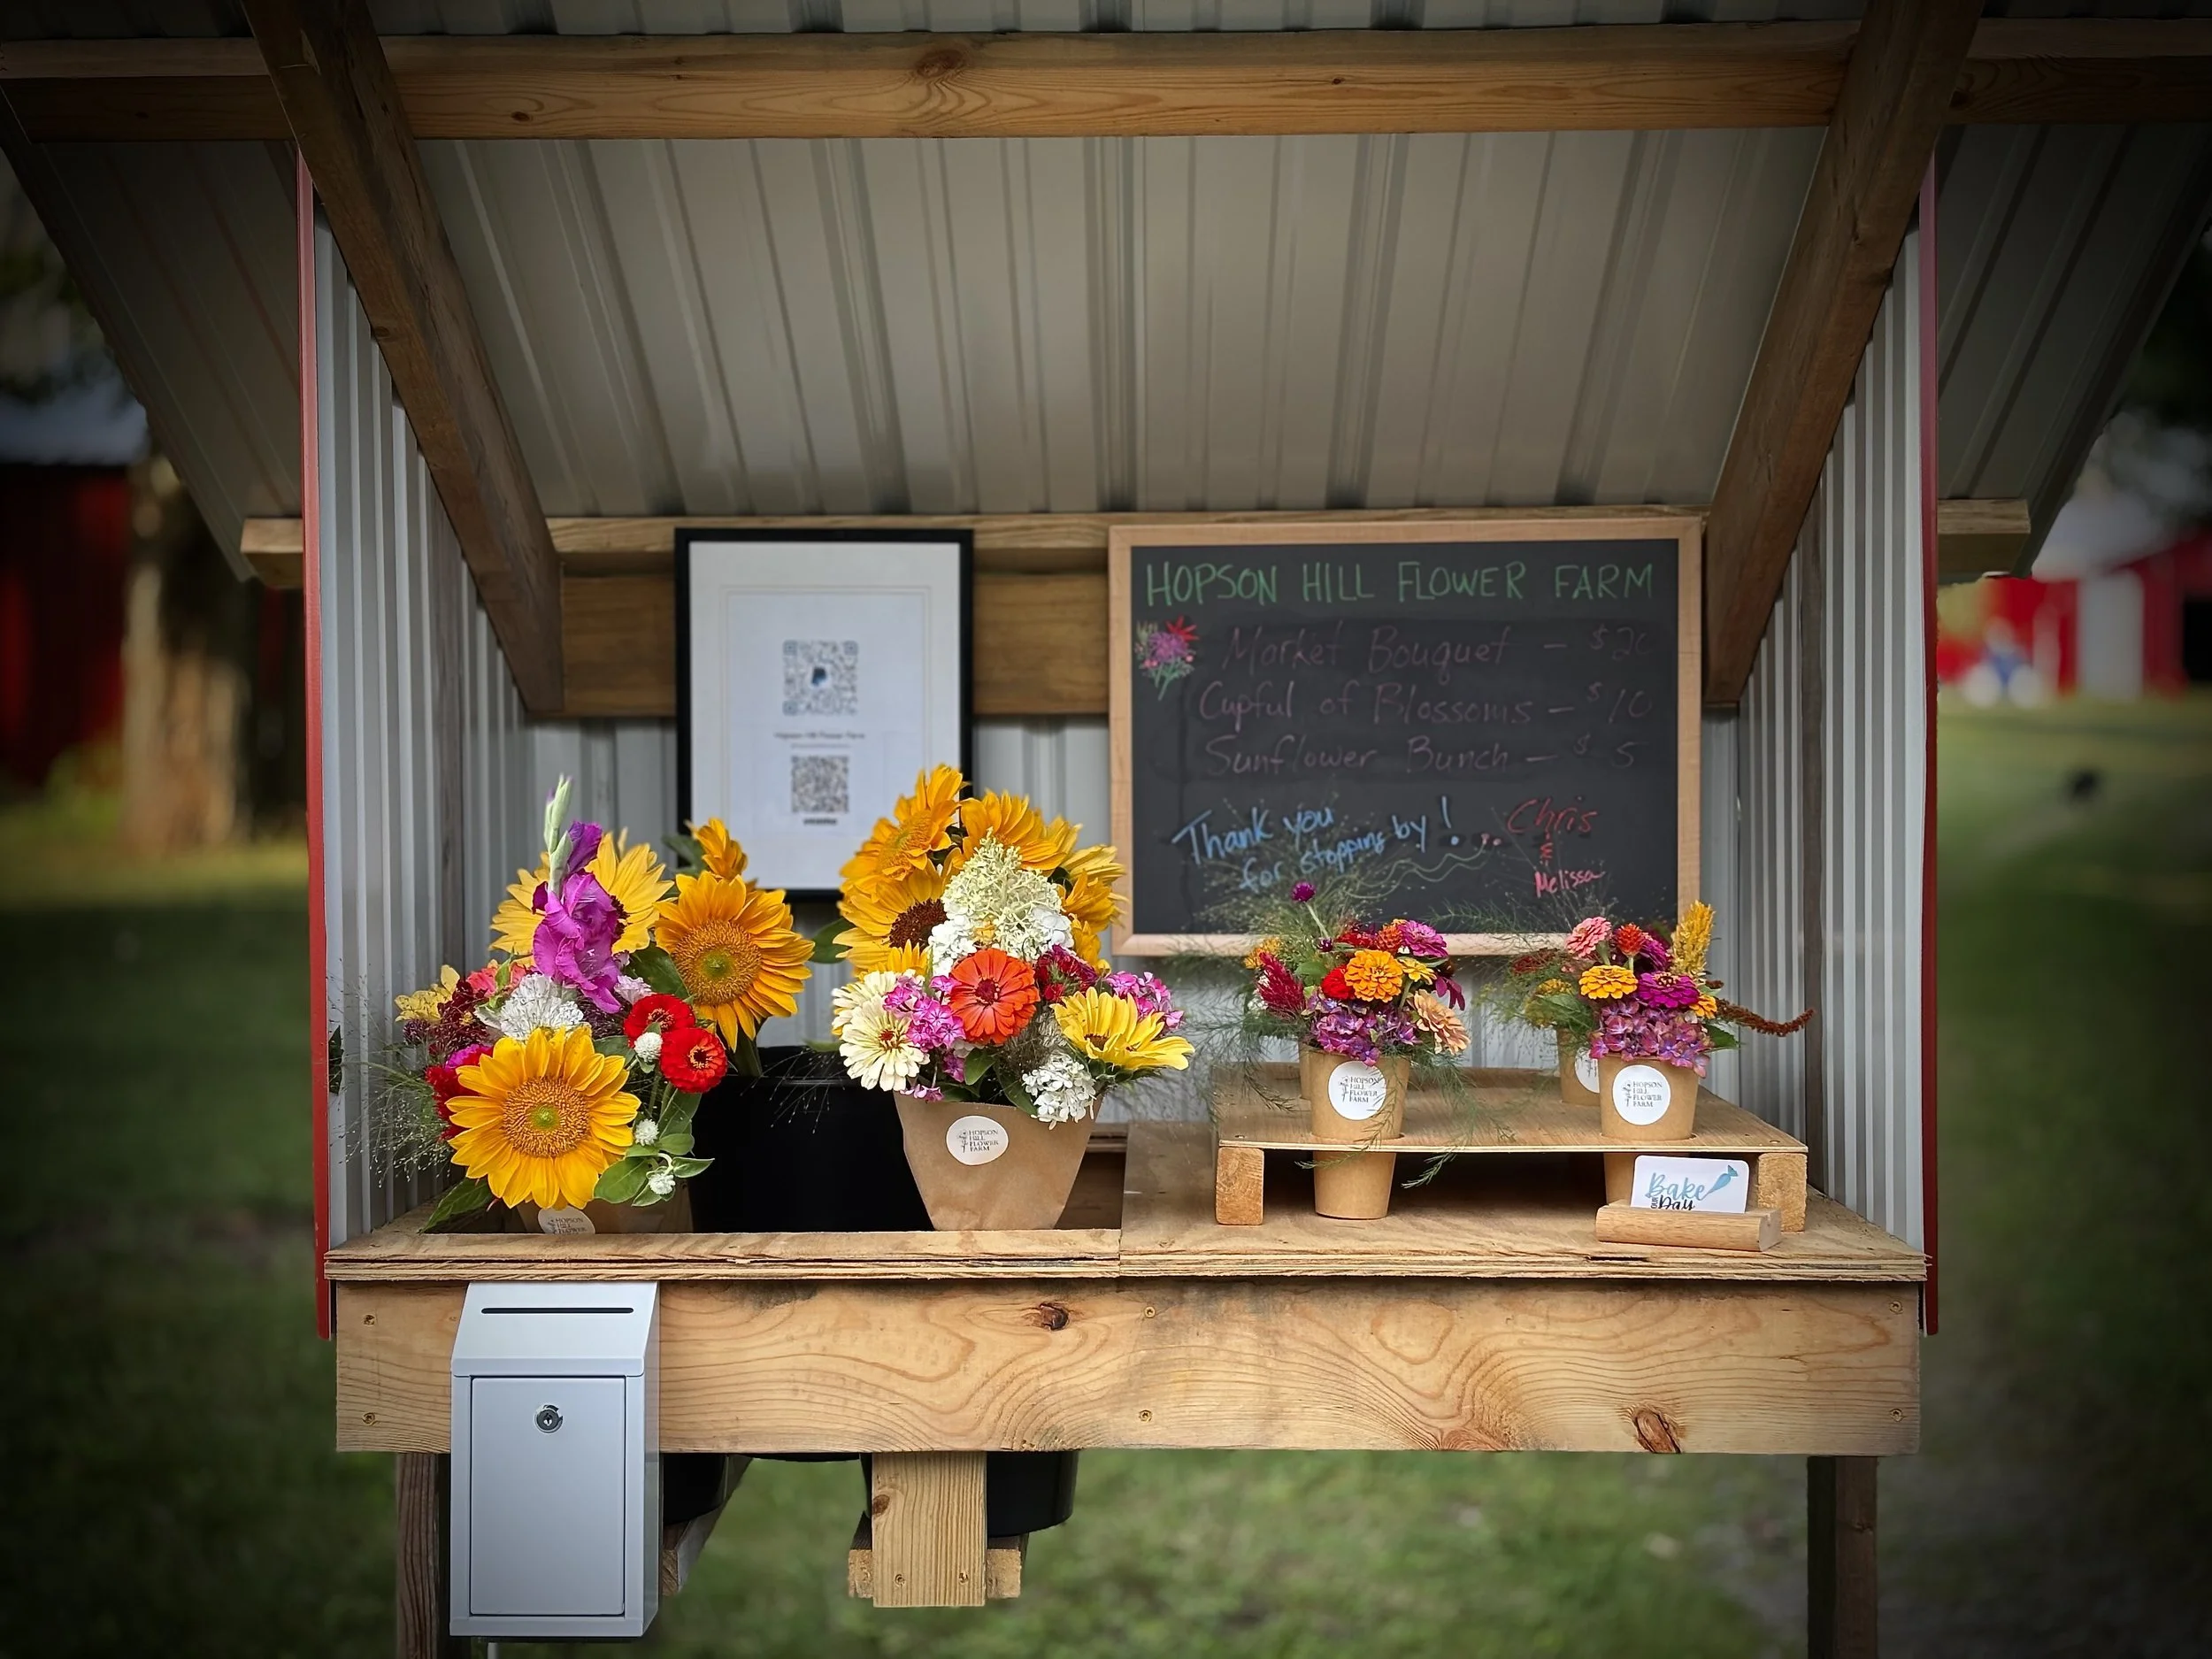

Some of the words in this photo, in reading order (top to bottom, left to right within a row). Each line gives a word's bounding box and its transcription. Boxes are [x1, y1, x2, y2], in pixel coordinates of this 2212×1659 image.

[1147, 561, 1278, 607] HOPSON
[1302, 562, 1376, 603] HILL
[1398, 560, 1527, 603] FLOWER
[1554, 563, 1654, 601] FARM
[1220, 620, 1343, 675] Market
[1367, 625, 1512, 686] Bouquet
[1198, 680, 1294, 733] Cupful
[1319, 679, 1359, 716] of
[1372, 681, 1532, 726] Blossoms
[1204, 733, 1379, 776] Sunflower
[1404, 735, 1509, 774] Bunch
[1171, 806, 1275, 866] Thank
[1282, 806, 1336, 851] you
[1506, 796, 1598, 833] Chris
[1239, 856, 1285, 894] for
[1299, 830, 1386, 874] stopping
[1534, 869, 1606, 898] Melissa
[1645, 1172, 1707, 1202] Bake
